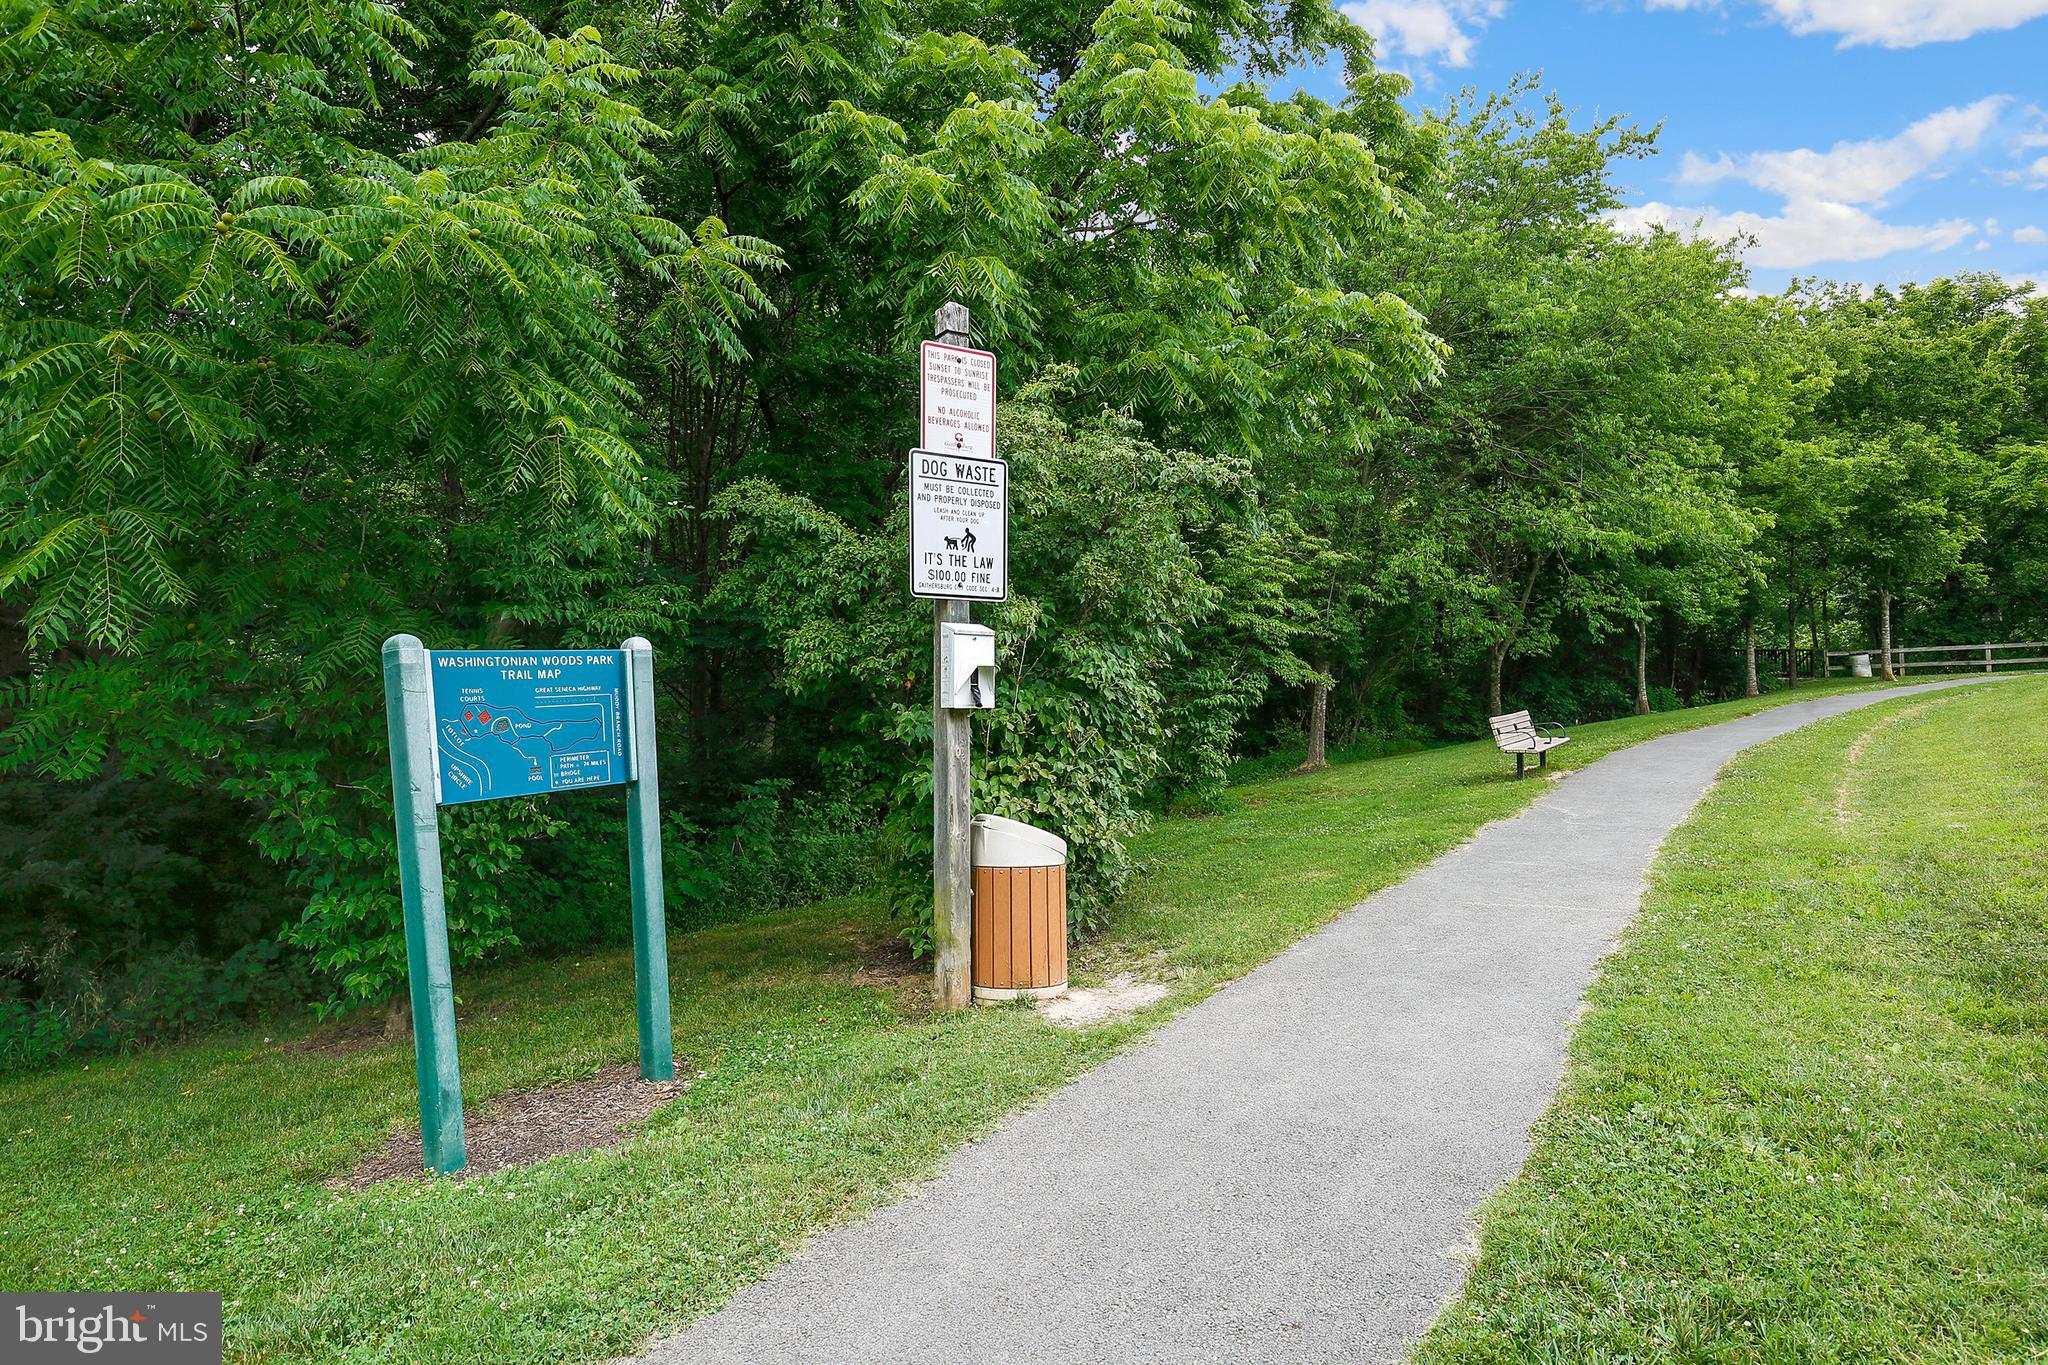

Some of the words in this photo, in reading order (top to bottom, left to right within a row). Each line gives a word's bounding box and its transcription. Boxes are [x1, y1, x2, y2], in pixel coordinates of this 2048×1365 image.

[928, 350, 940, 359] THIS
[944, 353, 959, 362] PARK
[962, 357, 967, 365] IS
[970, 358, 990, 369] CLOSED
[929, 362, 951, 373] SUNSET
[955, 367, 961, 375] TO
[965, 368, 988, 380] SUNRISE
[927, 373, 964, 388] TRESPASSERS
[968, 381, 980, 391] WILL
[984, 383, 990, 392] BE
[941, 387, 977, 401] PROSECUTED
[938, 406, 945, 414] NO
[949, 408, 980, 420] ALCOHOLIC
[928, 416, 960, 428] BEVERAGES
[964, 421, 989, 433] ALLOWED
[922, 459, 947, 477] DOG
[955, 463, 996, 482] WASTE
[924, 483, 942, 492] MUST
[946, 485, 954, 494] BE
[958, 487, 994, 498] COLLECTED
[917, 493, 931, 502] AND
[934, 495, 967, 506] PROPERLY
[971, 499, 1000, 510] DISPOSED
[924, 552, 942, 566] IT'S
[949, 554, 967, 567] THE
[974, 556, 993, 569] LAW
[928, 569, 966, 582] $100.00
[971, 572, 991, 584] FINE
[918, 582, 953, 590] GAITHERSBURG
[438, 656, 537, 667] WASHINGTONIAN
[542, 656, 583, 666] WOODS
[587, 655, 613, 665] PARK
[500, 670, 533, 680] TRAIL
[538, 669, 561, 679] MAP
[448, 771, 466, 789] CIRCLE
